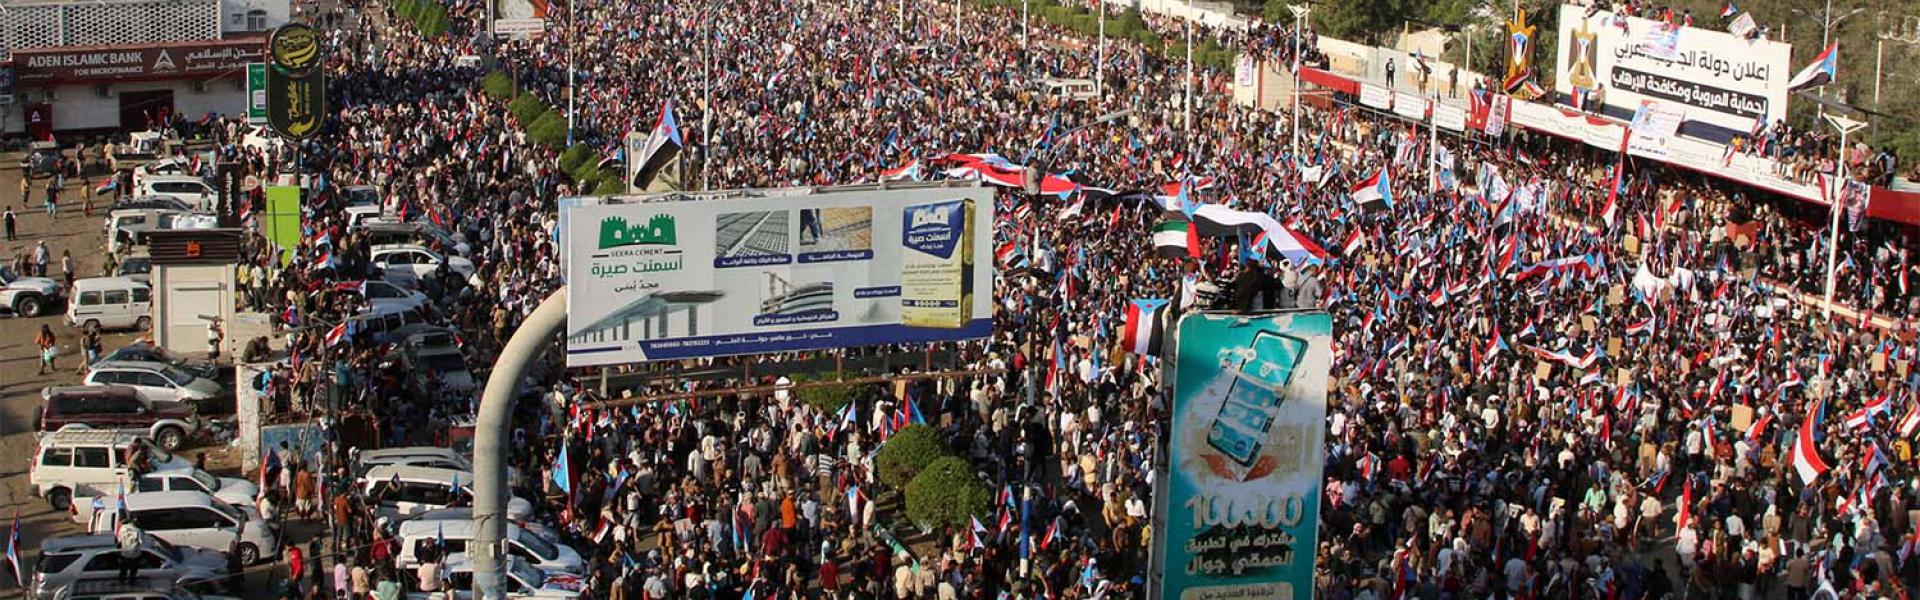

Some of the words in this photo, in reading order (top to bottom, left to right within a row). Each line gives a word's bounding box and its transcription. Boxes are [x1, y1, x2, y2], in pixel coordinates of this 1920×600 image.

[28, 55, 60, 68] ADEN
[63, 53, 108, 66] ISLAMIC
[110, 52, 142, 63] BANK
[184, 47, 233, 64] الإسلامي
[1699, 51, 1730, 77] دولة
[74, 69, 89, 77] FOR
[91, 66, 143, 75] MICROFINANCE
[1732, 61, 1770, 88] إعلان
[1612, 72, 1646, 94] الإرهاب
[1646, 76, 1693, 102] ومكافحة
[1692, 84, 1730, 107] العروبة
[1731, 94, 1767, 115] لحماية
[591, 262, 628, 278] صيرة
[632, 255, 683, 273] أسمنت
[1184, 535, 1227, 552] تطبيق
[1230, 536, 1250, 552] في
[1253, 531, 1297, 547] مشترك
[1185, 555, 1227, 575] جوال
[1231, 549, 1296, 574] العمقي
